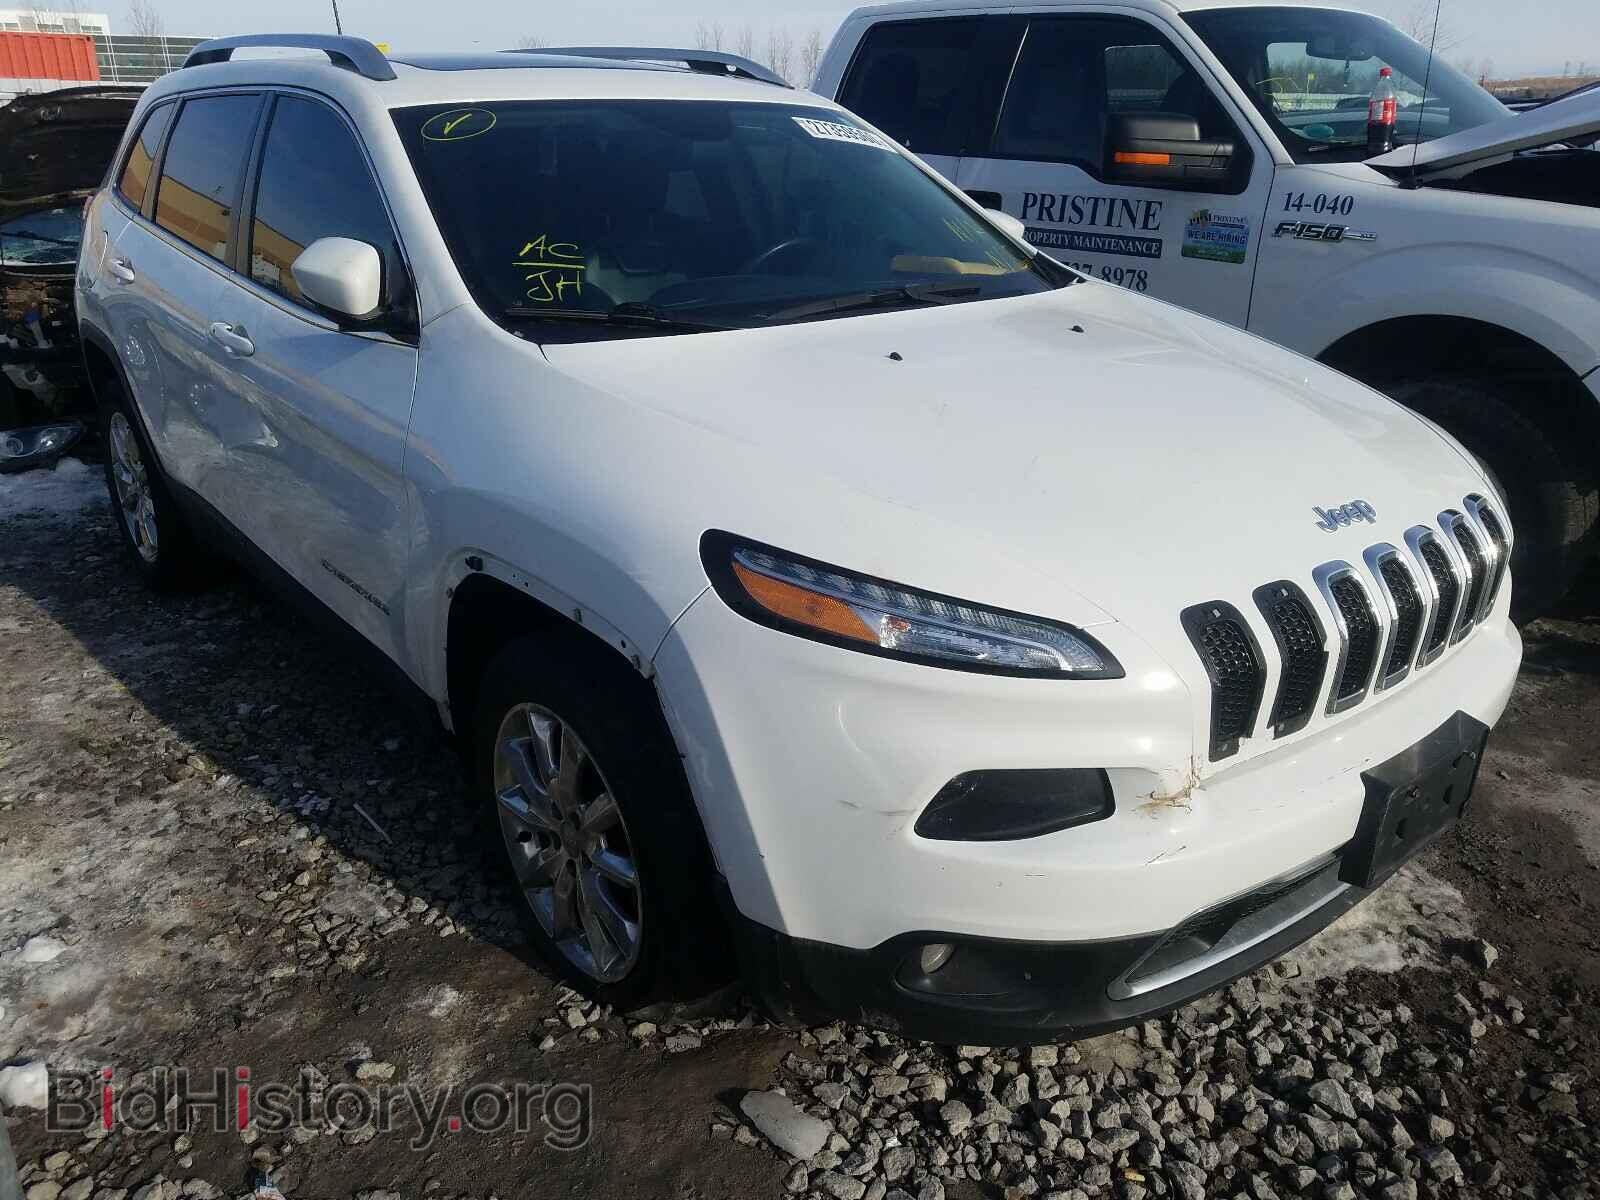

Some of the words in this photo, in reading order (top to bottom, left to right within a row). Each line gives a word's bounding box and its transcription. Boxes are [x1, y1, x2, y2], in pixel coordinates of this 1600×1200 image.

[1020, 192, 1163, 231] PRISTINE
[1283, 192, 1354, 216] 14-040
[519, 234, 585, 259] AC
[1023, 230, 1073, 245] ROPERTY
[1074, 235, 1161, 255] MAINTENANCE
[1201, 231, 1217, 240] ARE
[1312, 500, 1377, 533] Jeep
